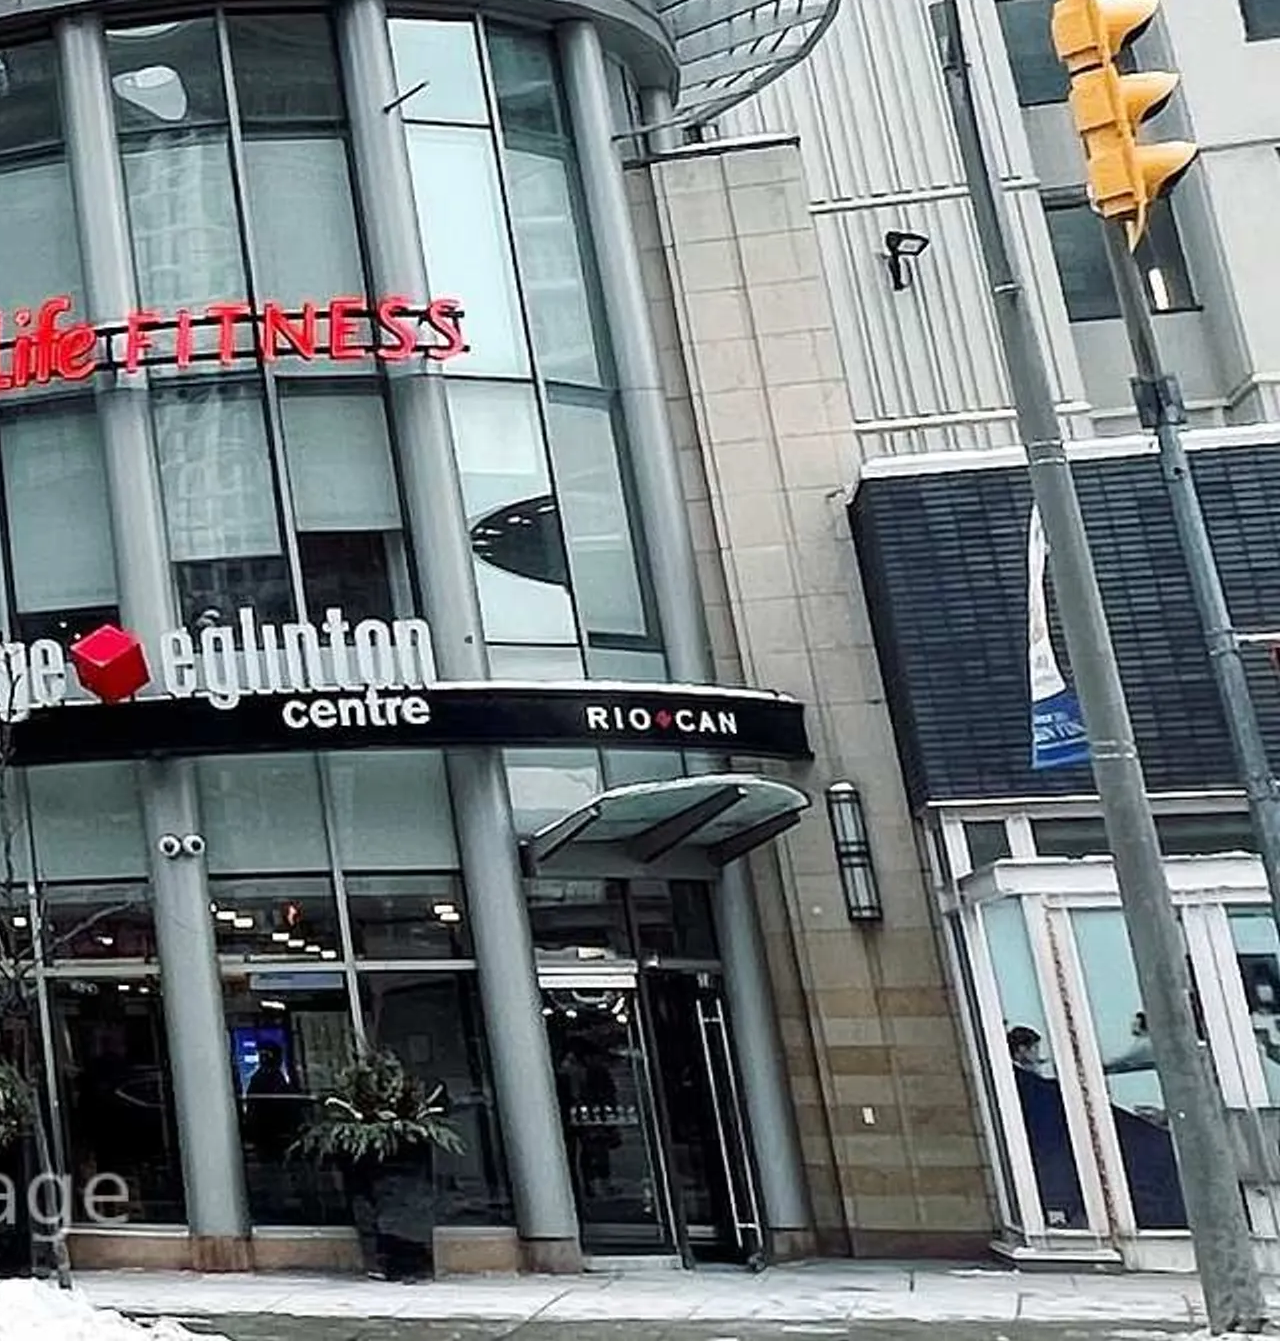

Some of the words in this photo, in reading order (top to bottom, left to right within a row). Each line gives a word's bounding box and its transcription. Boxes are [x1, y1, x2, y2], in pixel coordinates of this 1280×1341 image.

[124, 294, 466, 373] FITNESS
[159, 607, 439, 709] eglinton
[282, 689, 432, 729] centre
